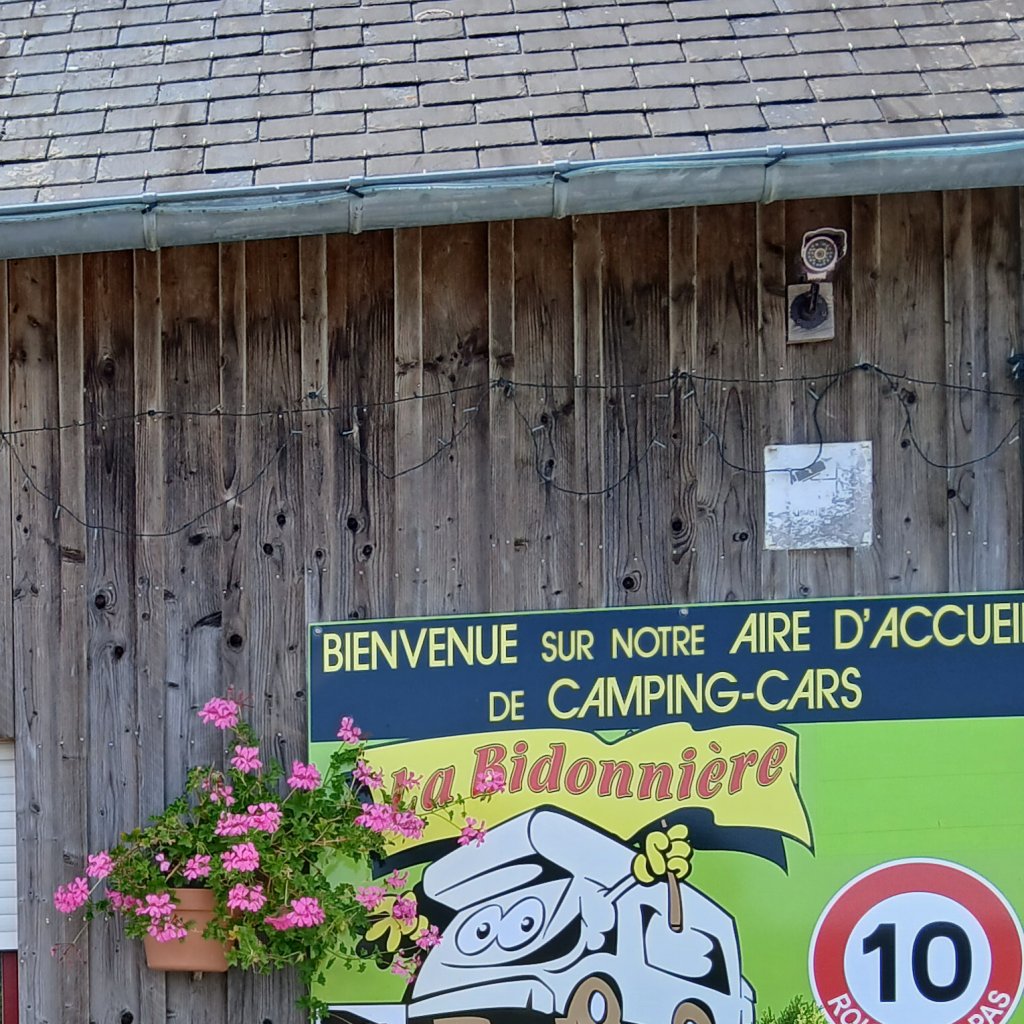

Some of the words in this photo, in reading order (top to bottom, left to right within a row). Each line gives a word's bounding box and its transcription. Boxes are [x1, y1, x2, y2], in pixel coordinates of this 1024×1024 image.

[322, 624, 518, 673] BIENVENUE
[540, 629, 595, 663] SUR
[611, 624, 705, 660] NOTRE
[729, 609, 811, 655] AIRE
[833, 602, 1024, 650] D'ACCUEI
[488, 690, 525, 722] DE
[547, 667, 863, 720] CAMPING-CARS
[470, 741, 788, 801] Bidonnière
[862, 920, 972, 1003] 10
